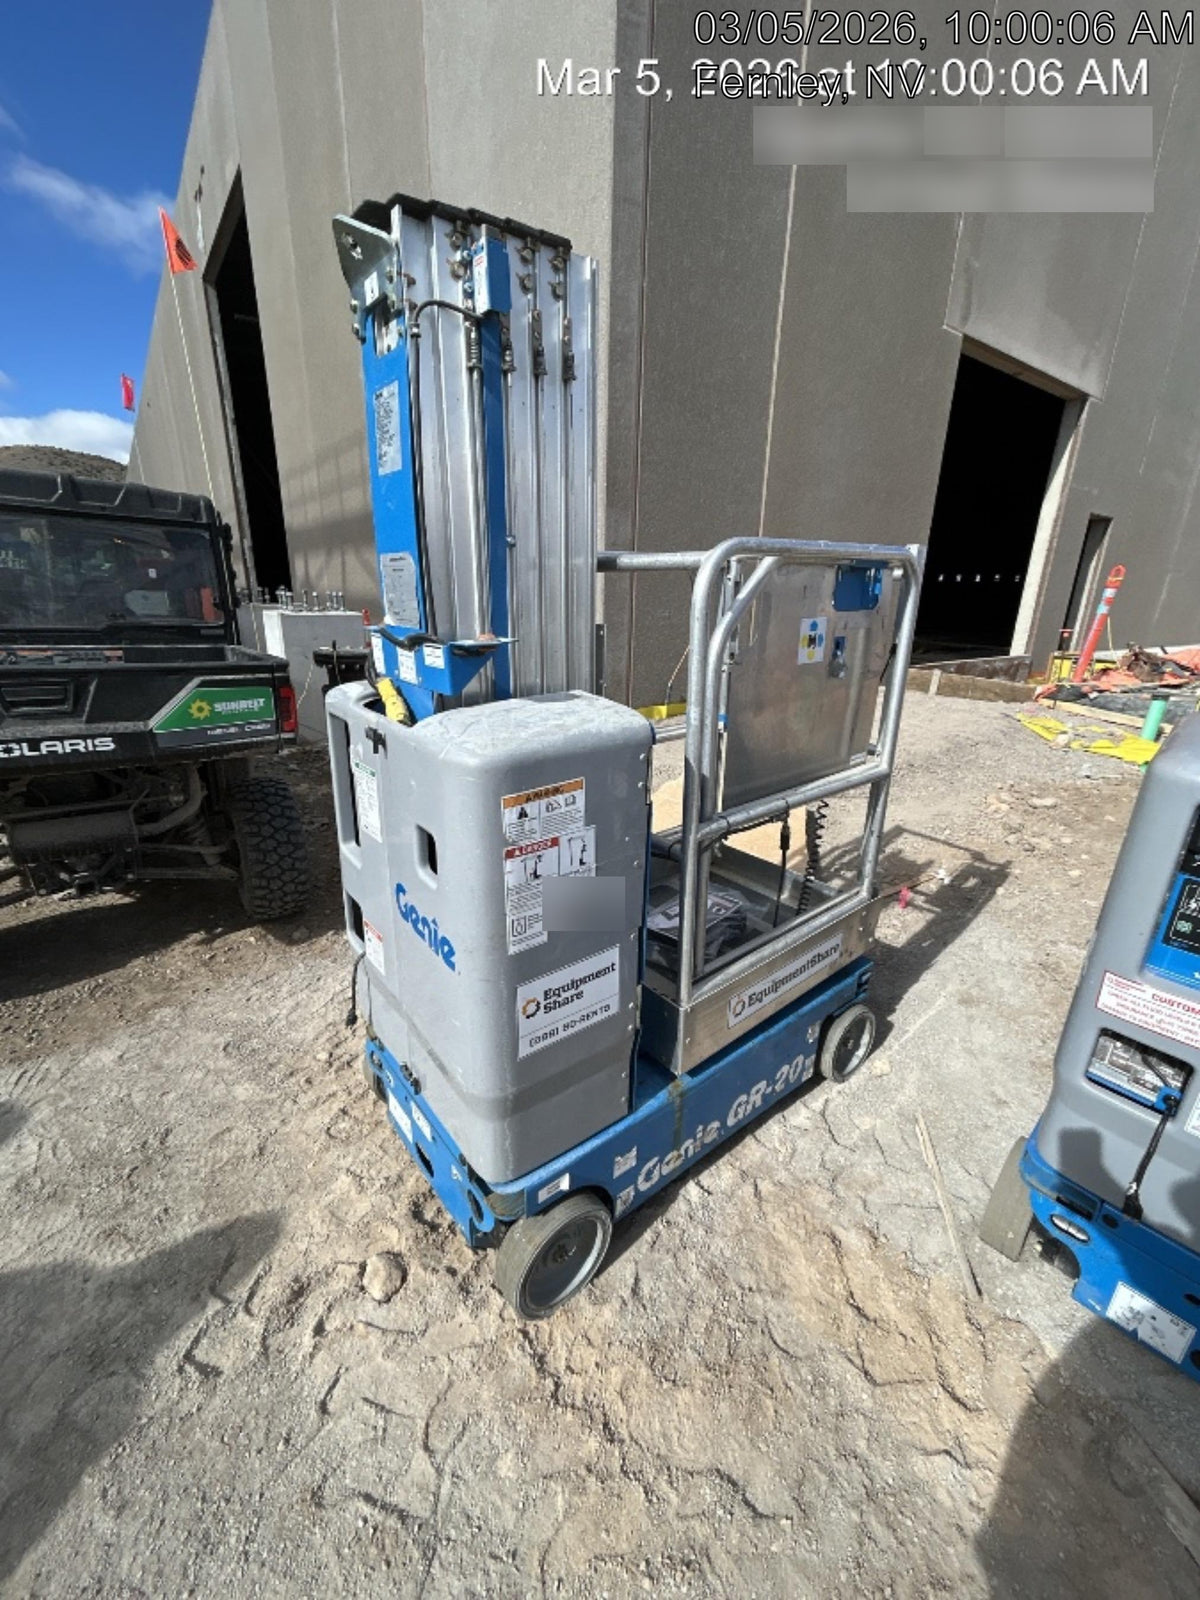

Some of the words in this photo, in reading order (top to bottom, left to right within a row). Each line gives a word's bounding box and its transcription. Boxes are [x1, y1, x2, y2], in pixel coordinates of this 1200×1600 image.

[394, 881, 457, 973] Genie
[543, 962, 617, 1001] Equipment
[543, 990, 585, 1015] Share
[747, 942, 841, 1007] EquipmentShare
[637, 1120, 722, 1192] Genie
[727, 1053, 805, 1128] GR-20
